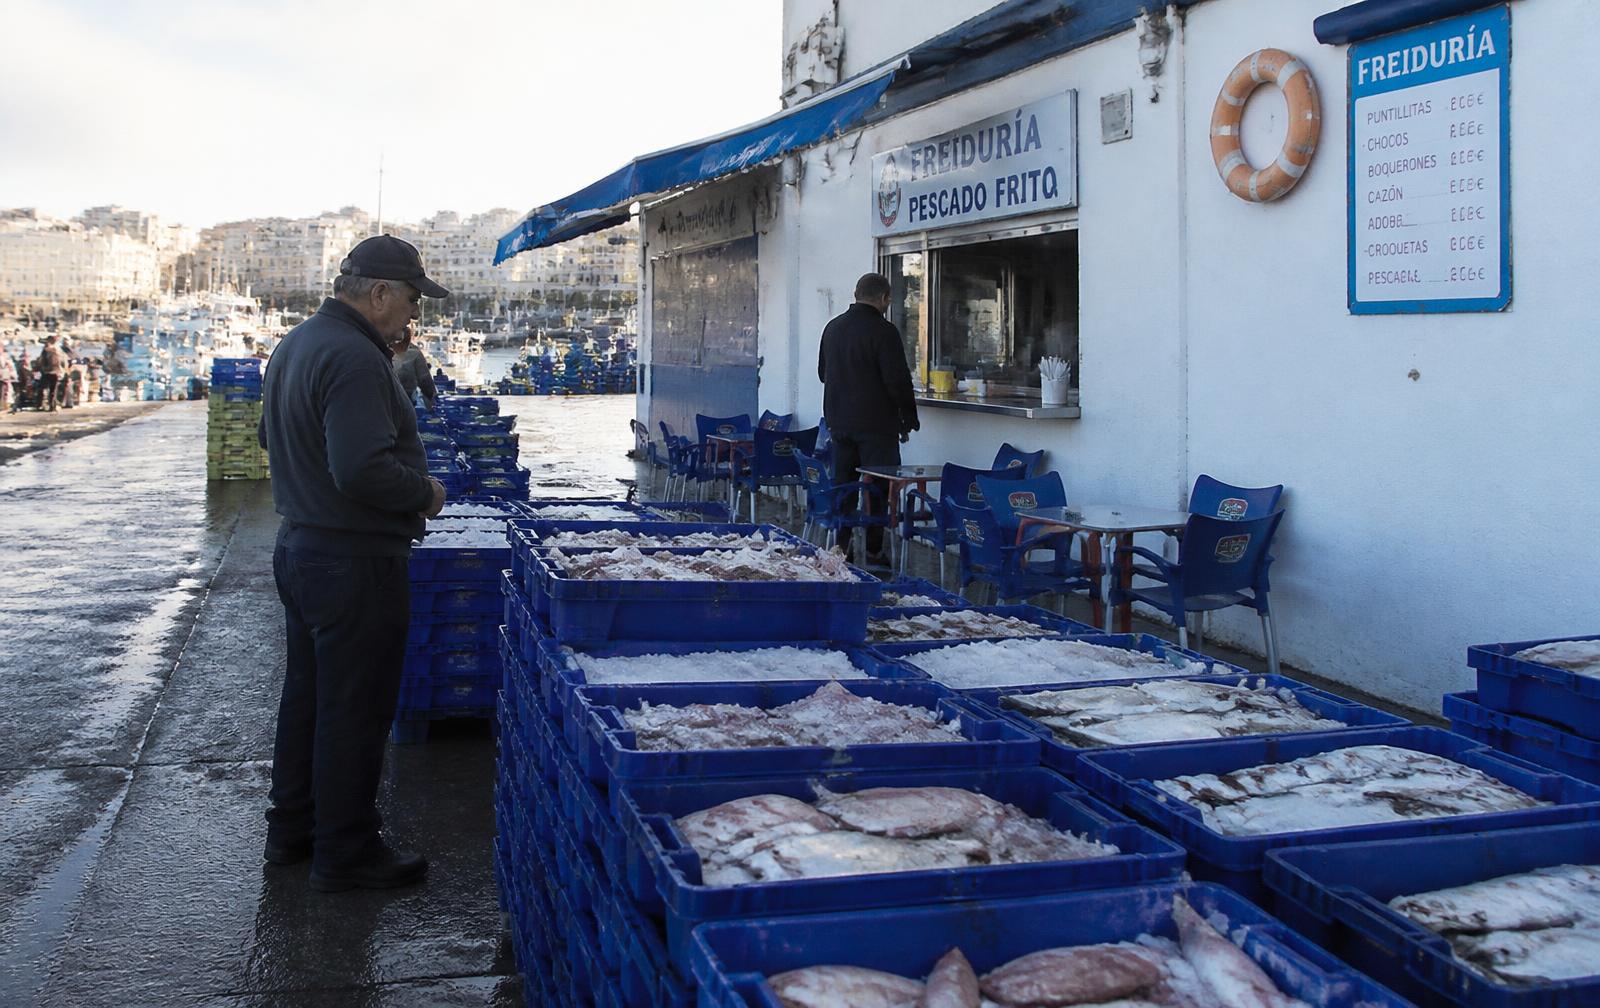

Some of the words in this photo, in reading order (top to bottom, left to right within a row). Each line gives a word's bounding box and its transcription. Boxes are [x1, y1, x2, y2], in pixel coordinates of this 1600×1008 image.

[1358, 24, 1496, 85] FREIDURÍA
[1367, 100, 1432, 125] PUNTILLITAS
[911, 109, 1041, 181] FREIDURÍA
[1367, 132, 1409, 151] CHOCOS
[1368, 154, 1437, 178] BOQUERONES
[909, 182, 987, 223] PESCADO
[1368, 184, 1403, 204] CAZÓN
